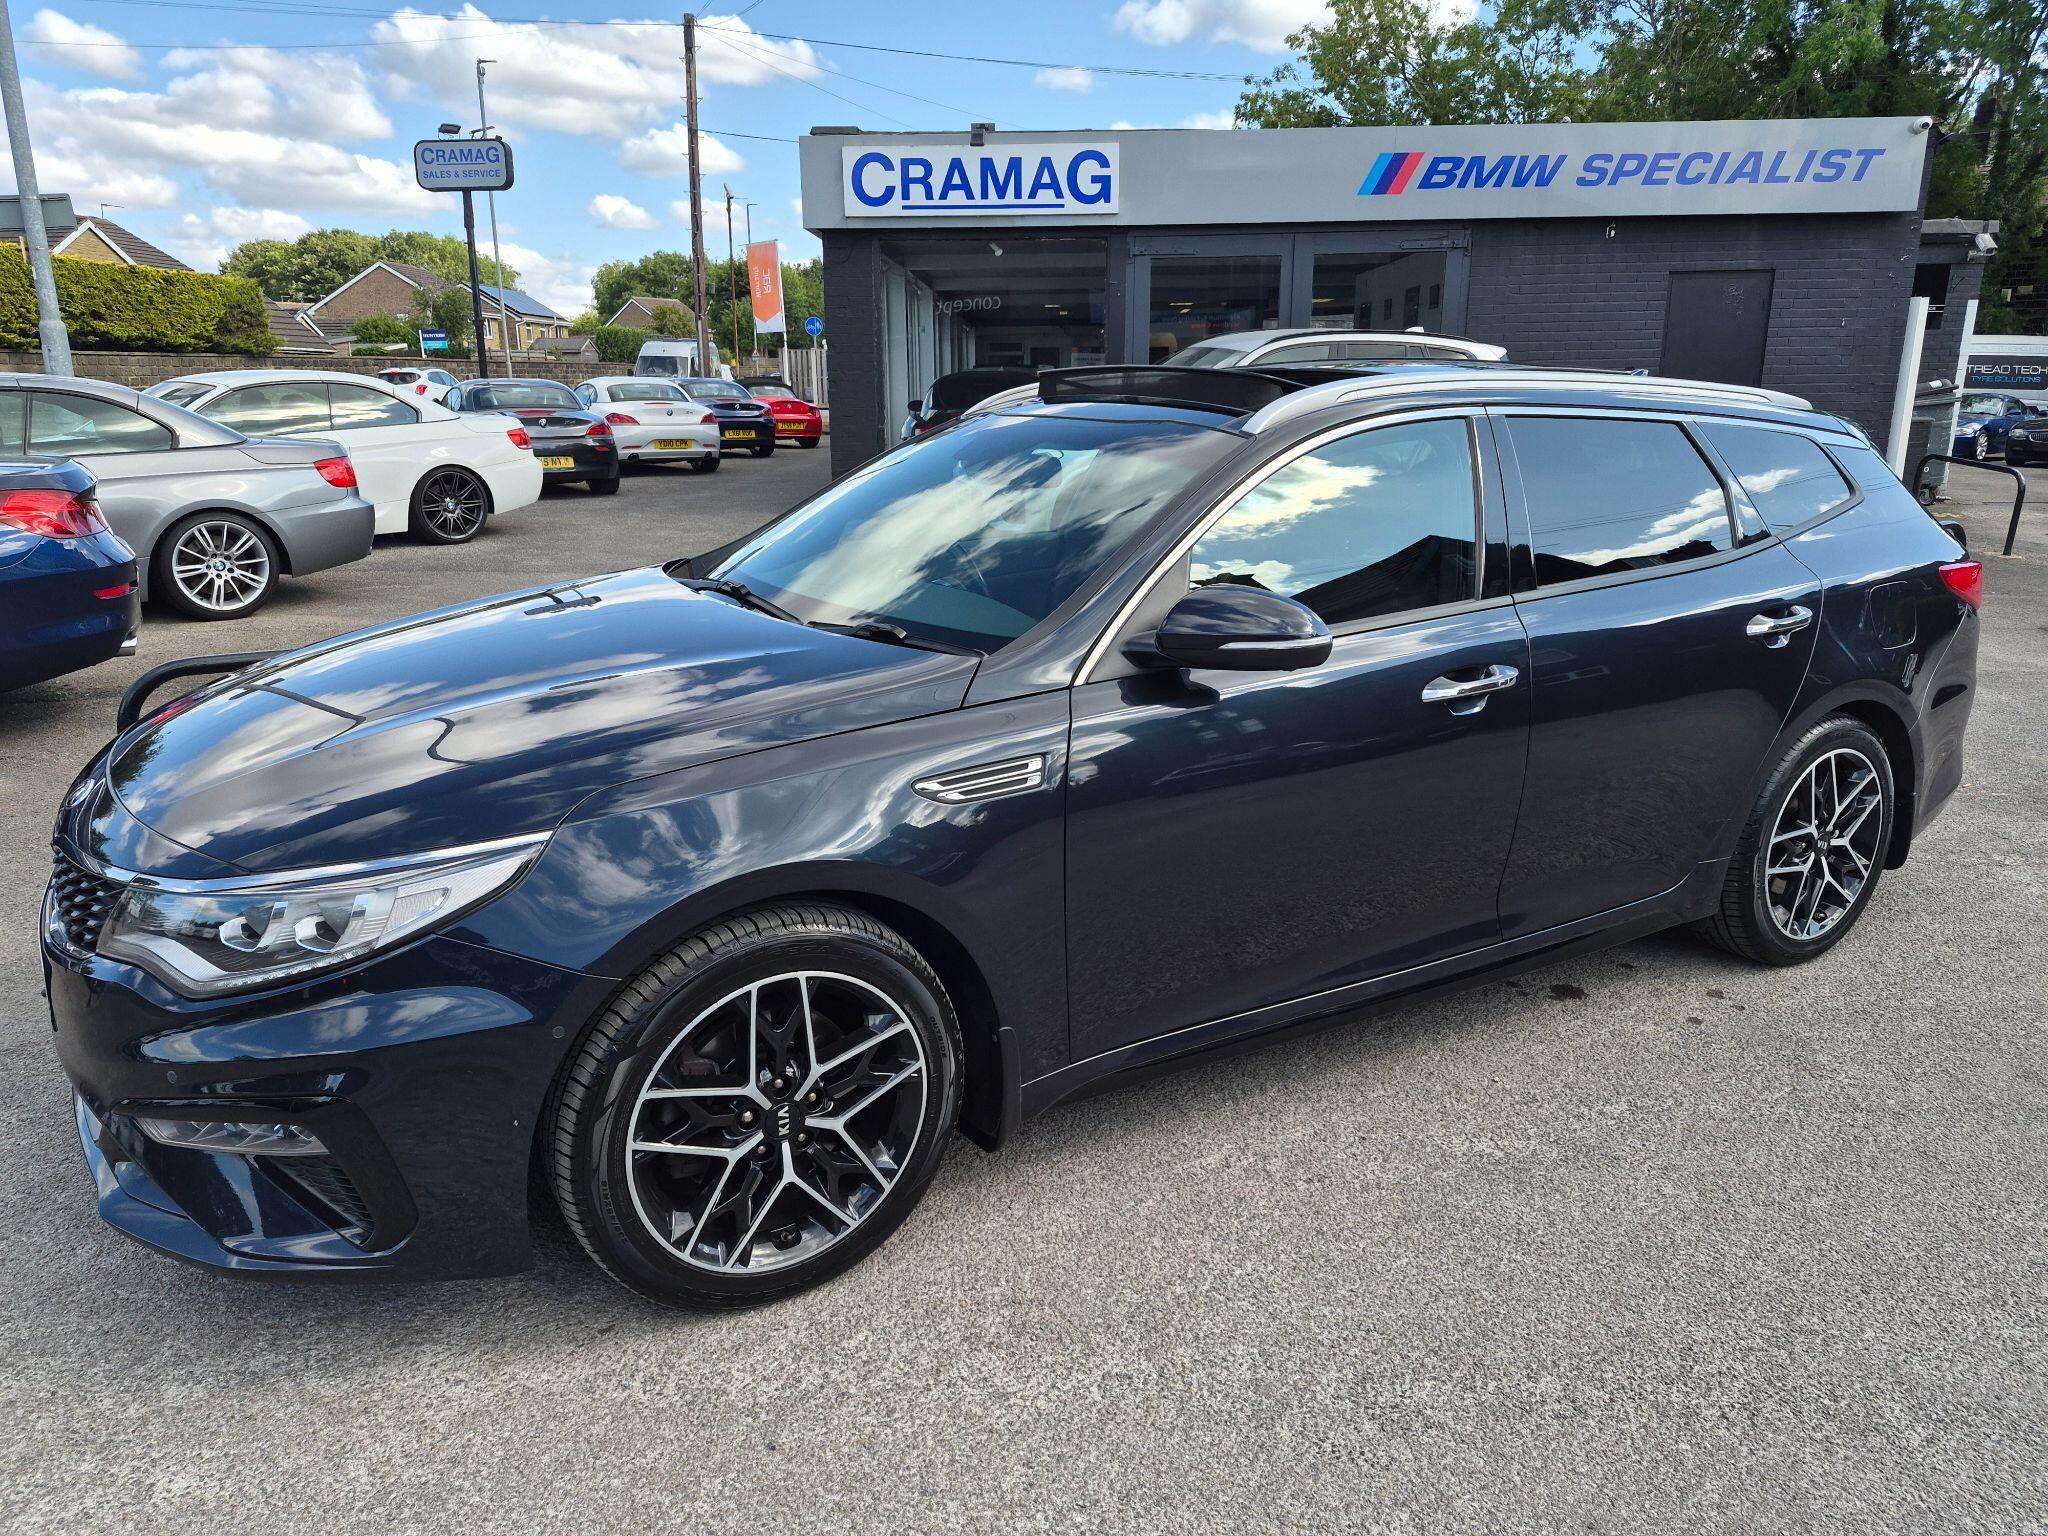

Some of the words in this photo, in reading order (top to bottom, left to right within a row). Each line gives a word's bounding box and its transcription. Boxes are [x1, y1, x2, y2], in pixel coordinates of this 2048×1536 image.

[421, 146, 499, 164] CRAMAG
[423, 170, 451, 179] SALES
[454, 170, 461, 178] &
[462, 169, 500, 178] SERVICE
[852, 150, 1111, 207] CRAMAG
[1416, 154, 1568, 190] BMW
[1576, 148, 1886, 187] SPECIALIST
[1967, 365, 2011, 374] TREAD
[2012, 365, 2048, 375] TECH
[778, 1105, 790, 1136] KIA
